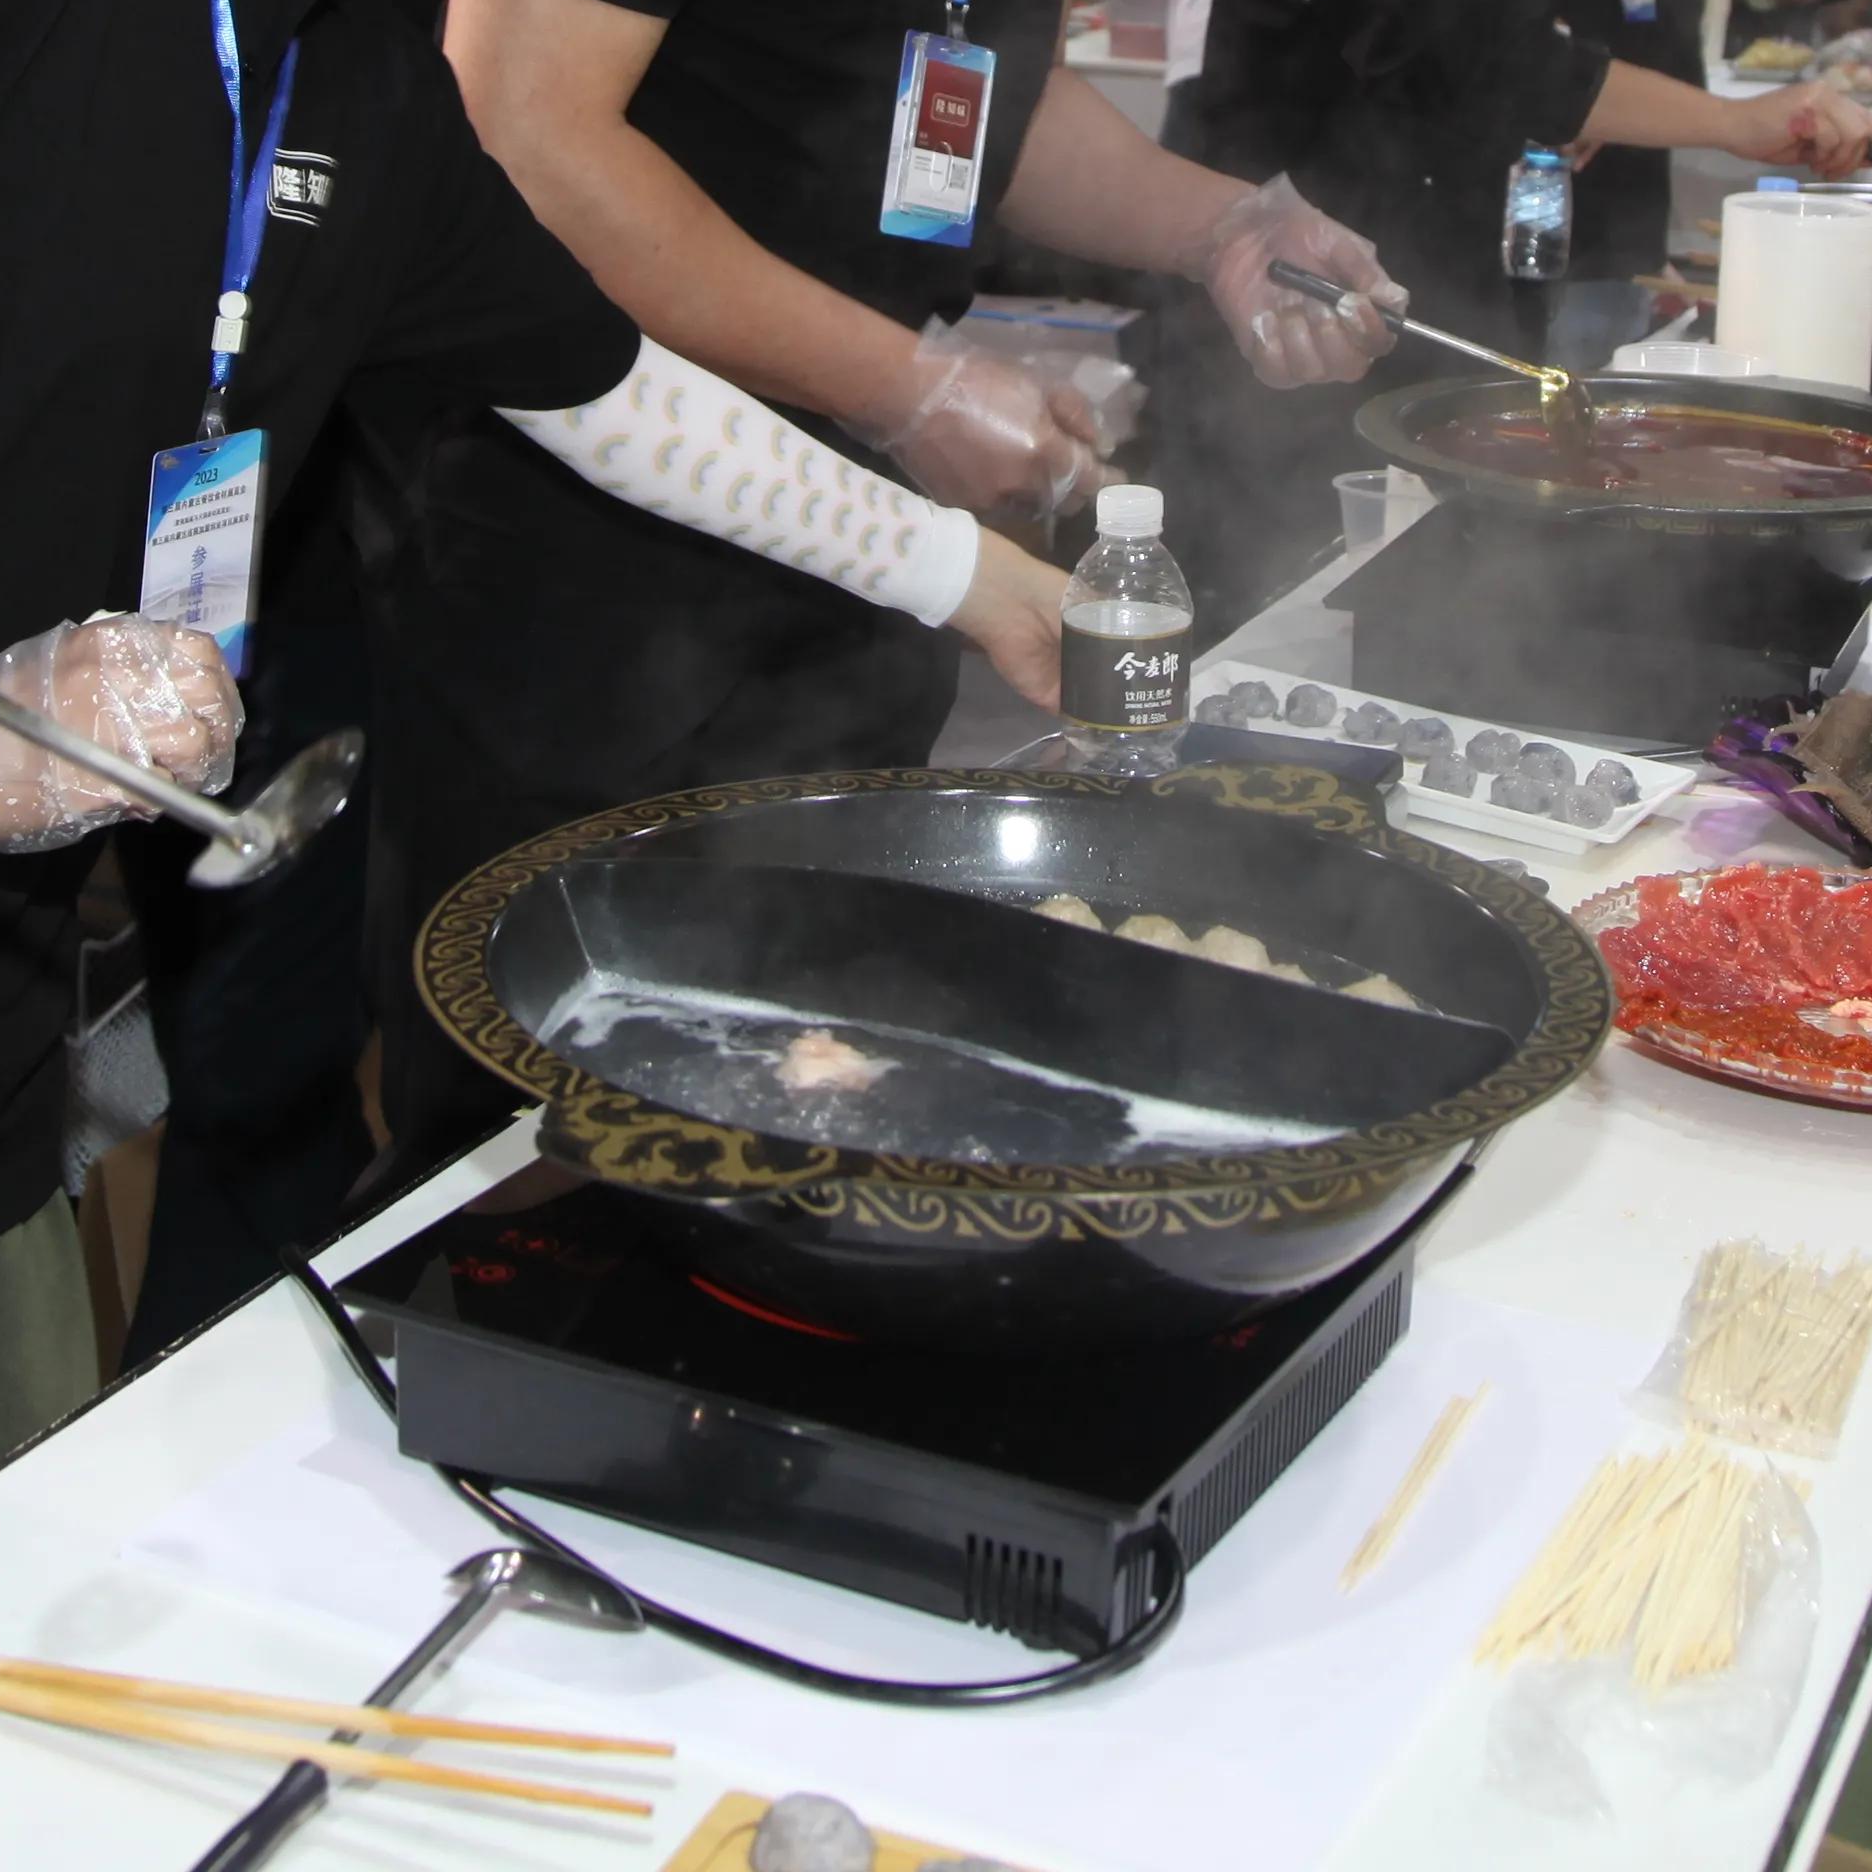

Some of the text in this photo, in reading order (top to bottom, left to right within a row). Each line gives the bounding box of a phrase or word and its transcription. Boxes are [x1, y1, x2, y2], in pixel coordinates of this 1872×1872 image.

[194, 467, 219, 487] 2023
[1113, 651, 1179, 684] 今麦郎
